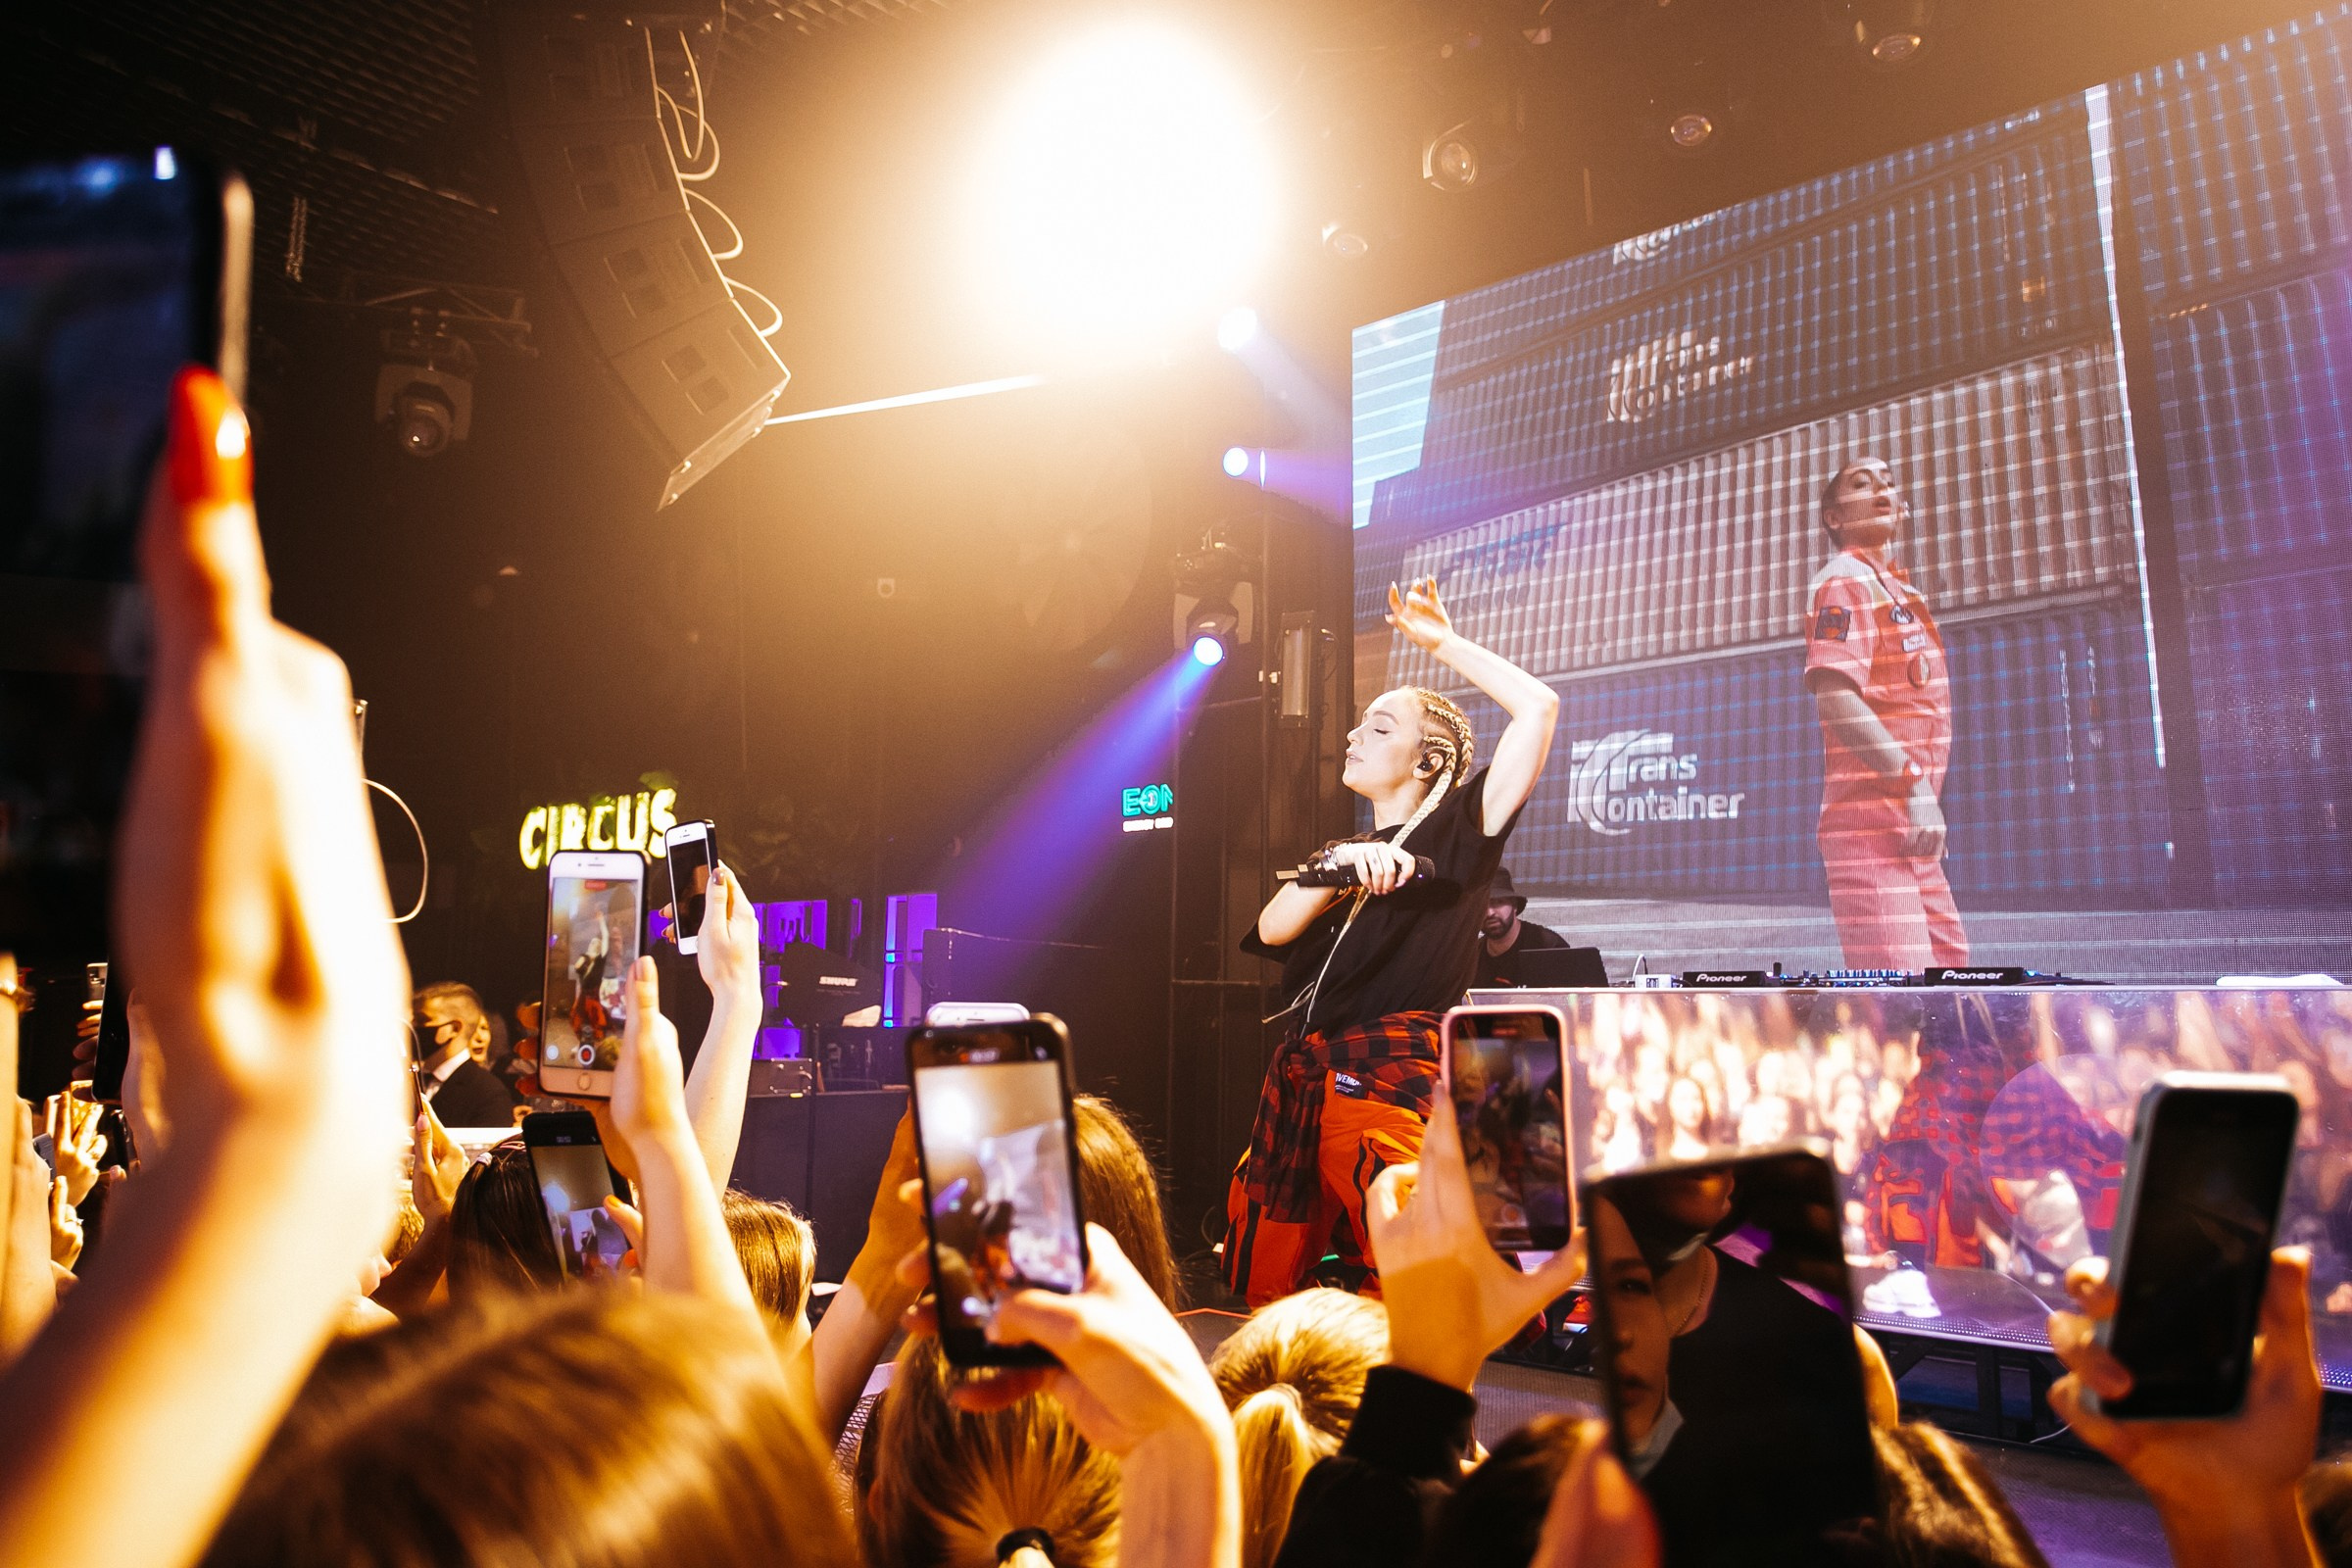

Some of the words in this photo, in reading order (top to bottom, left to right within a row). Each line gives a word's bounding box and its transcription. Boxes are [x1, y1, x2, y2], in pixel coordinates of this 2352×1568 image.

[1571, 729, 1698, 792] Trans
[519, 787, 678, 870] CIRCUS
[1695, 973, 1747, 983] Pioneer
[1941, 969, 2004, 980] Pioneer
